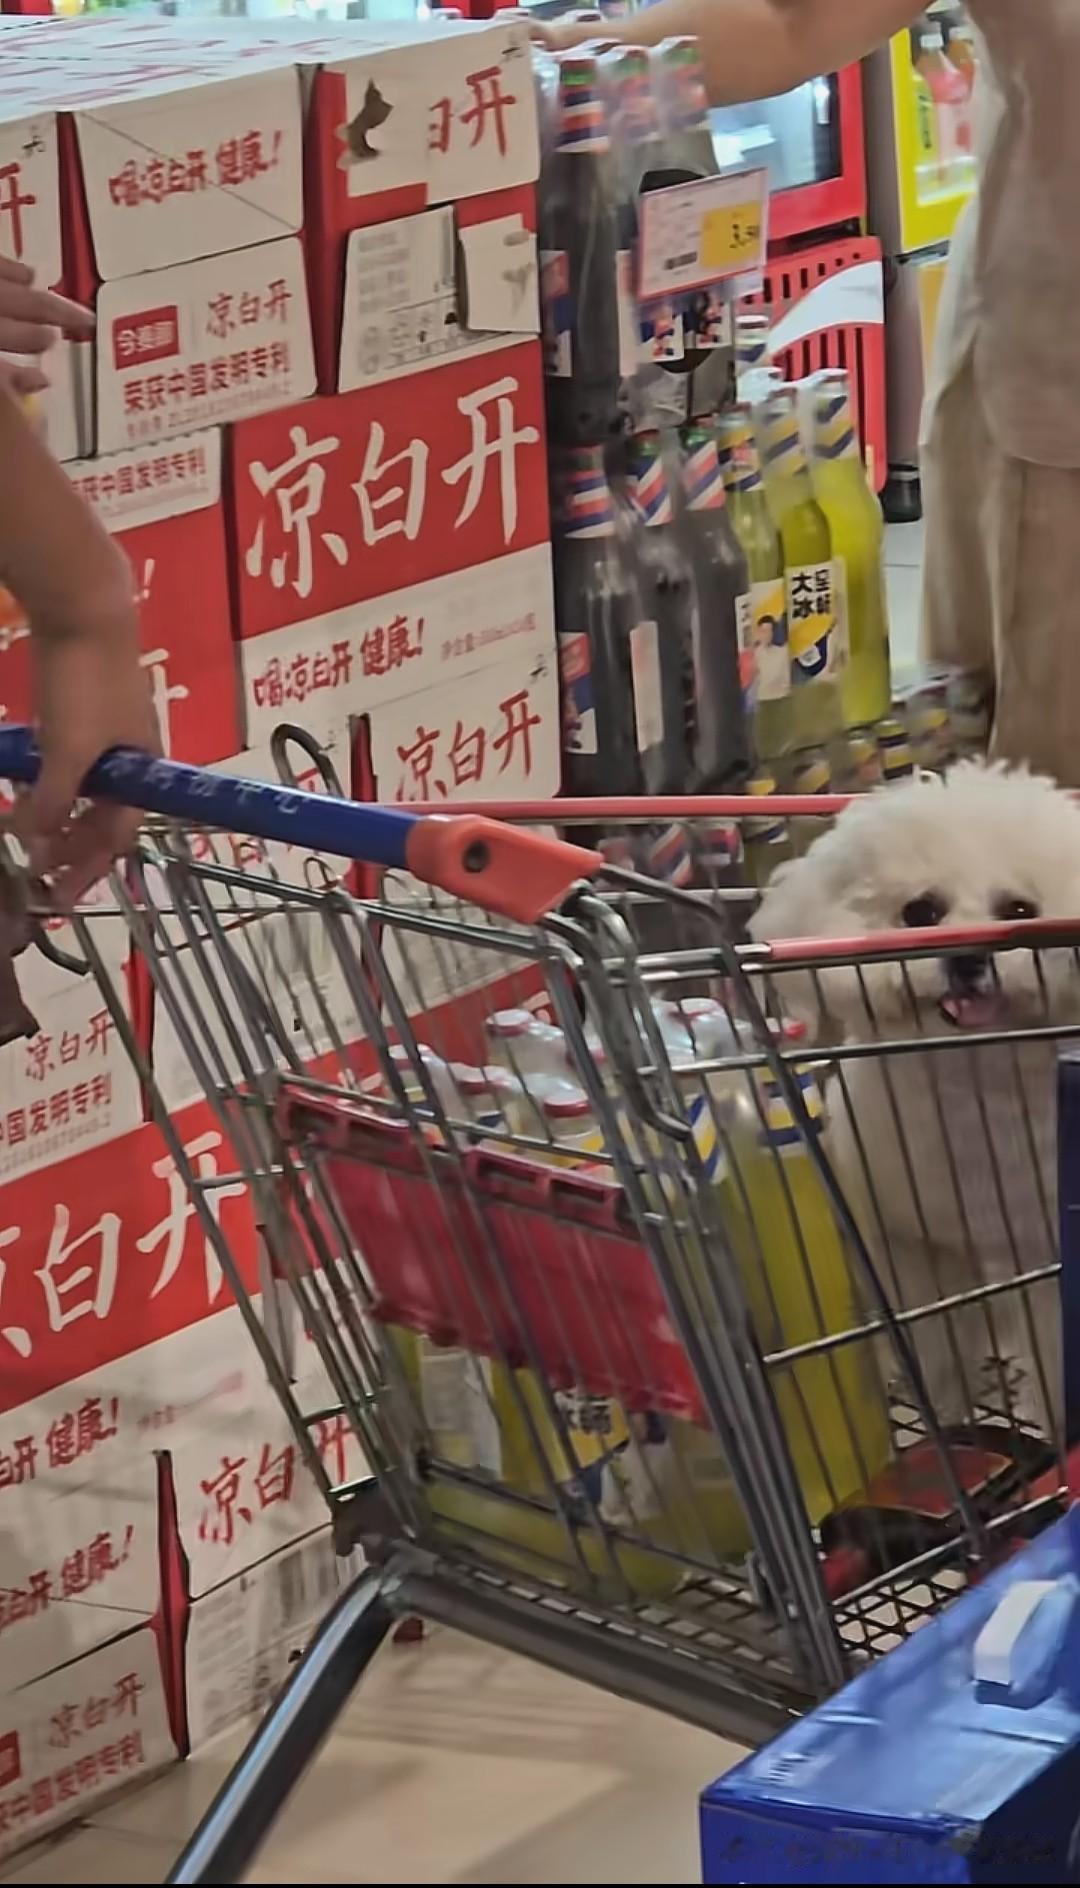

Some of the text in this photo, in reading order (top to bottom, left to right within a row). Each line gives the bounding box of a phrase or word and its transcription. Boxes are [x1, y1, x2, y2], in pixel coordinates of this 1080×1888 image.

[109, 150, 207, 206] 喝凉白开
[206, 279, 291, 339] 凉白开
[124, 341, 290, 416] 荣获中国发明专利
[246, 376, 540, 599] 凉白开
[253, 641, 352, 707] 喝凉白开
[396, 689, 541, 801] 凉白开
[25, 1009, 115, 1081] 凉白开
[49, 1672, 145, 1748] 凉白开
